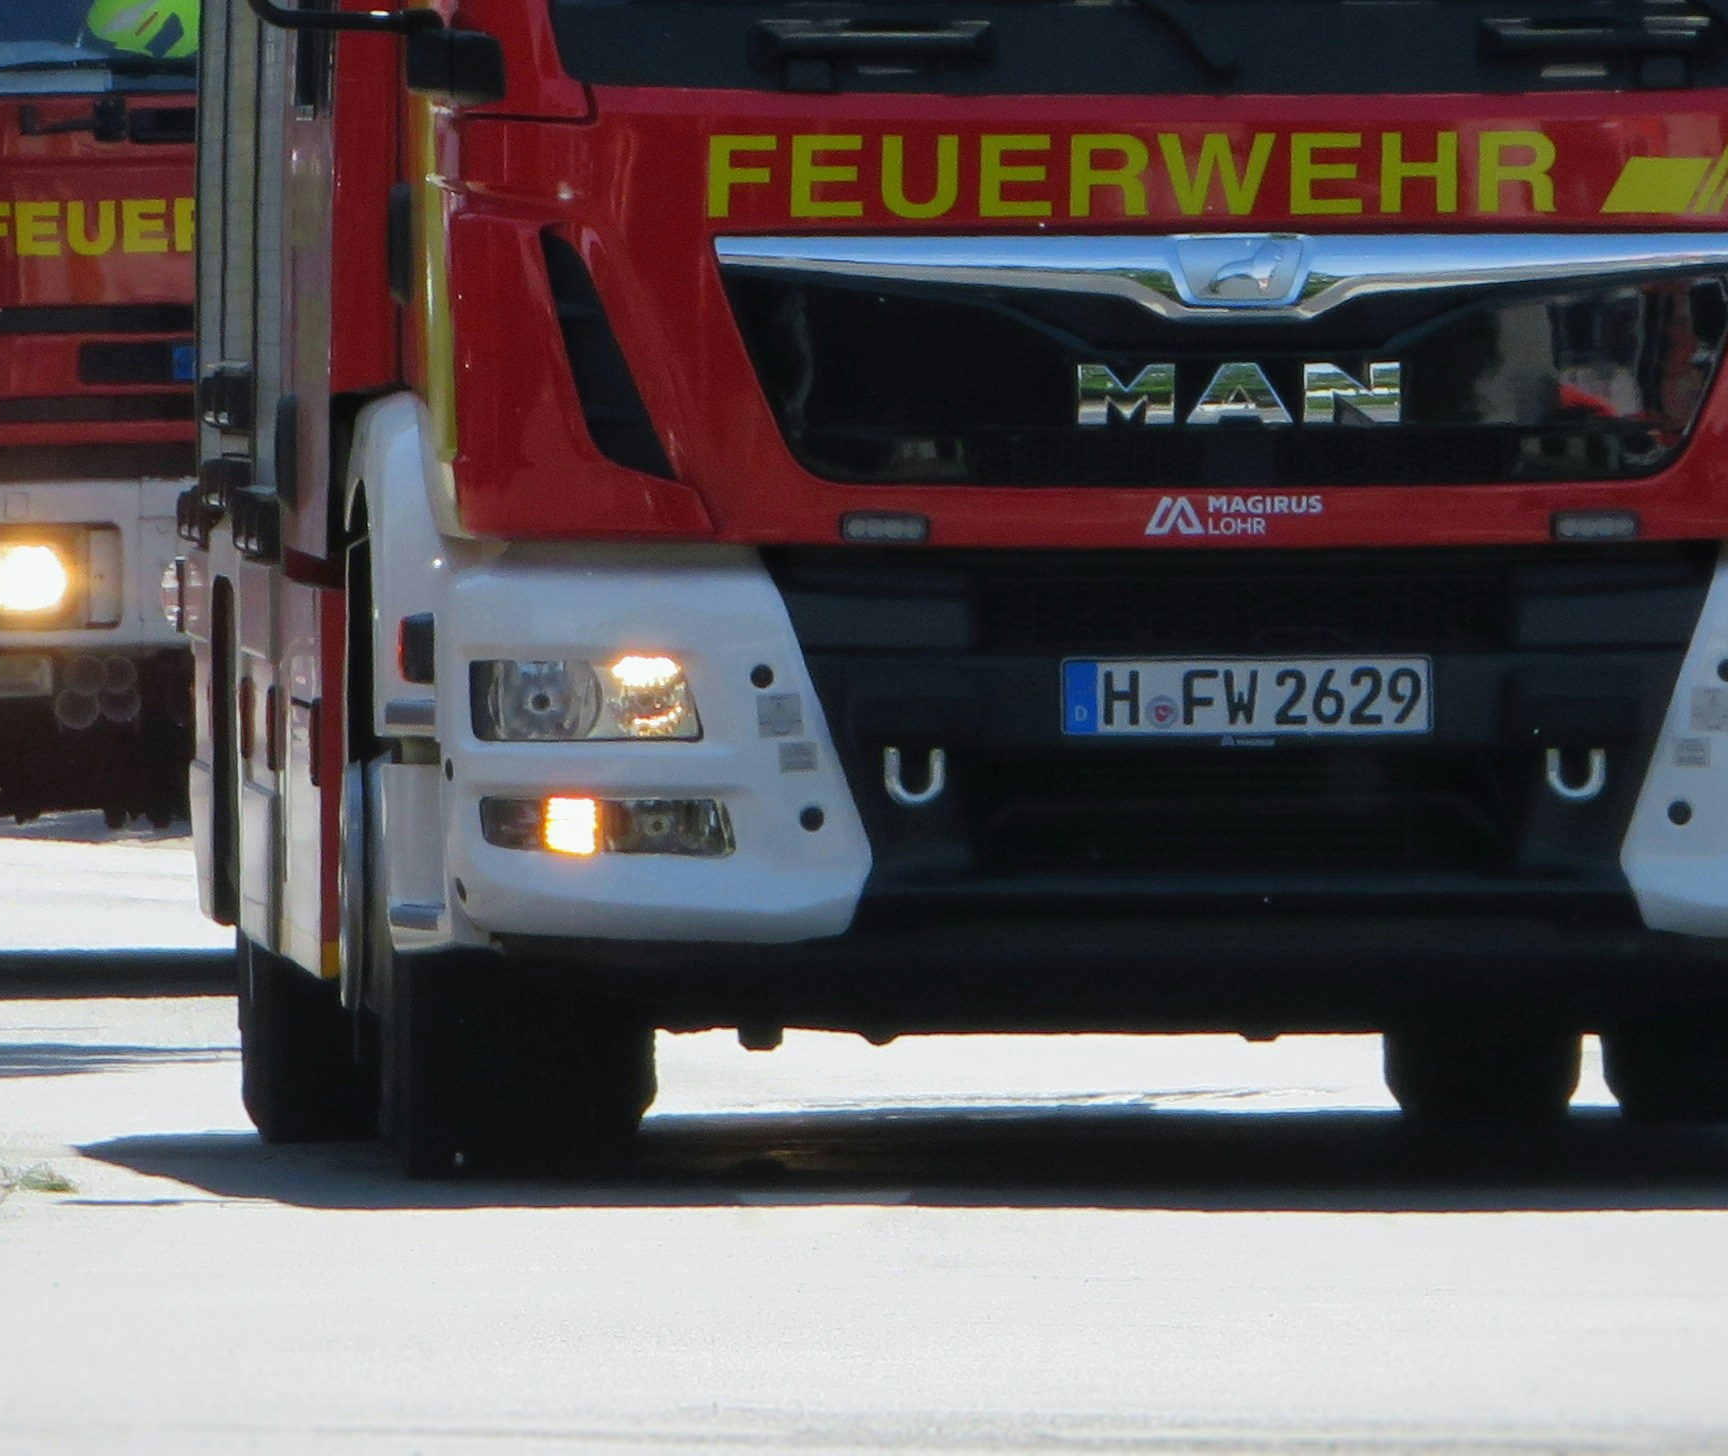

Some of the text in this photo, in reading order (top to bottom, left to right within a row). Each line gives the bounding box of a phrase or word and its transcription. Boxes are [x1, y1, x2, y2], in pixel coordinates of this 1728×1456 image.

[707, 130, 1556, 219] FEUERWEHR
[1077, 361, 1401, 426] MAN
[1207, 495, 1323, 514] MAGIRUS
[1207, 517, 1266, 535] LOHR
